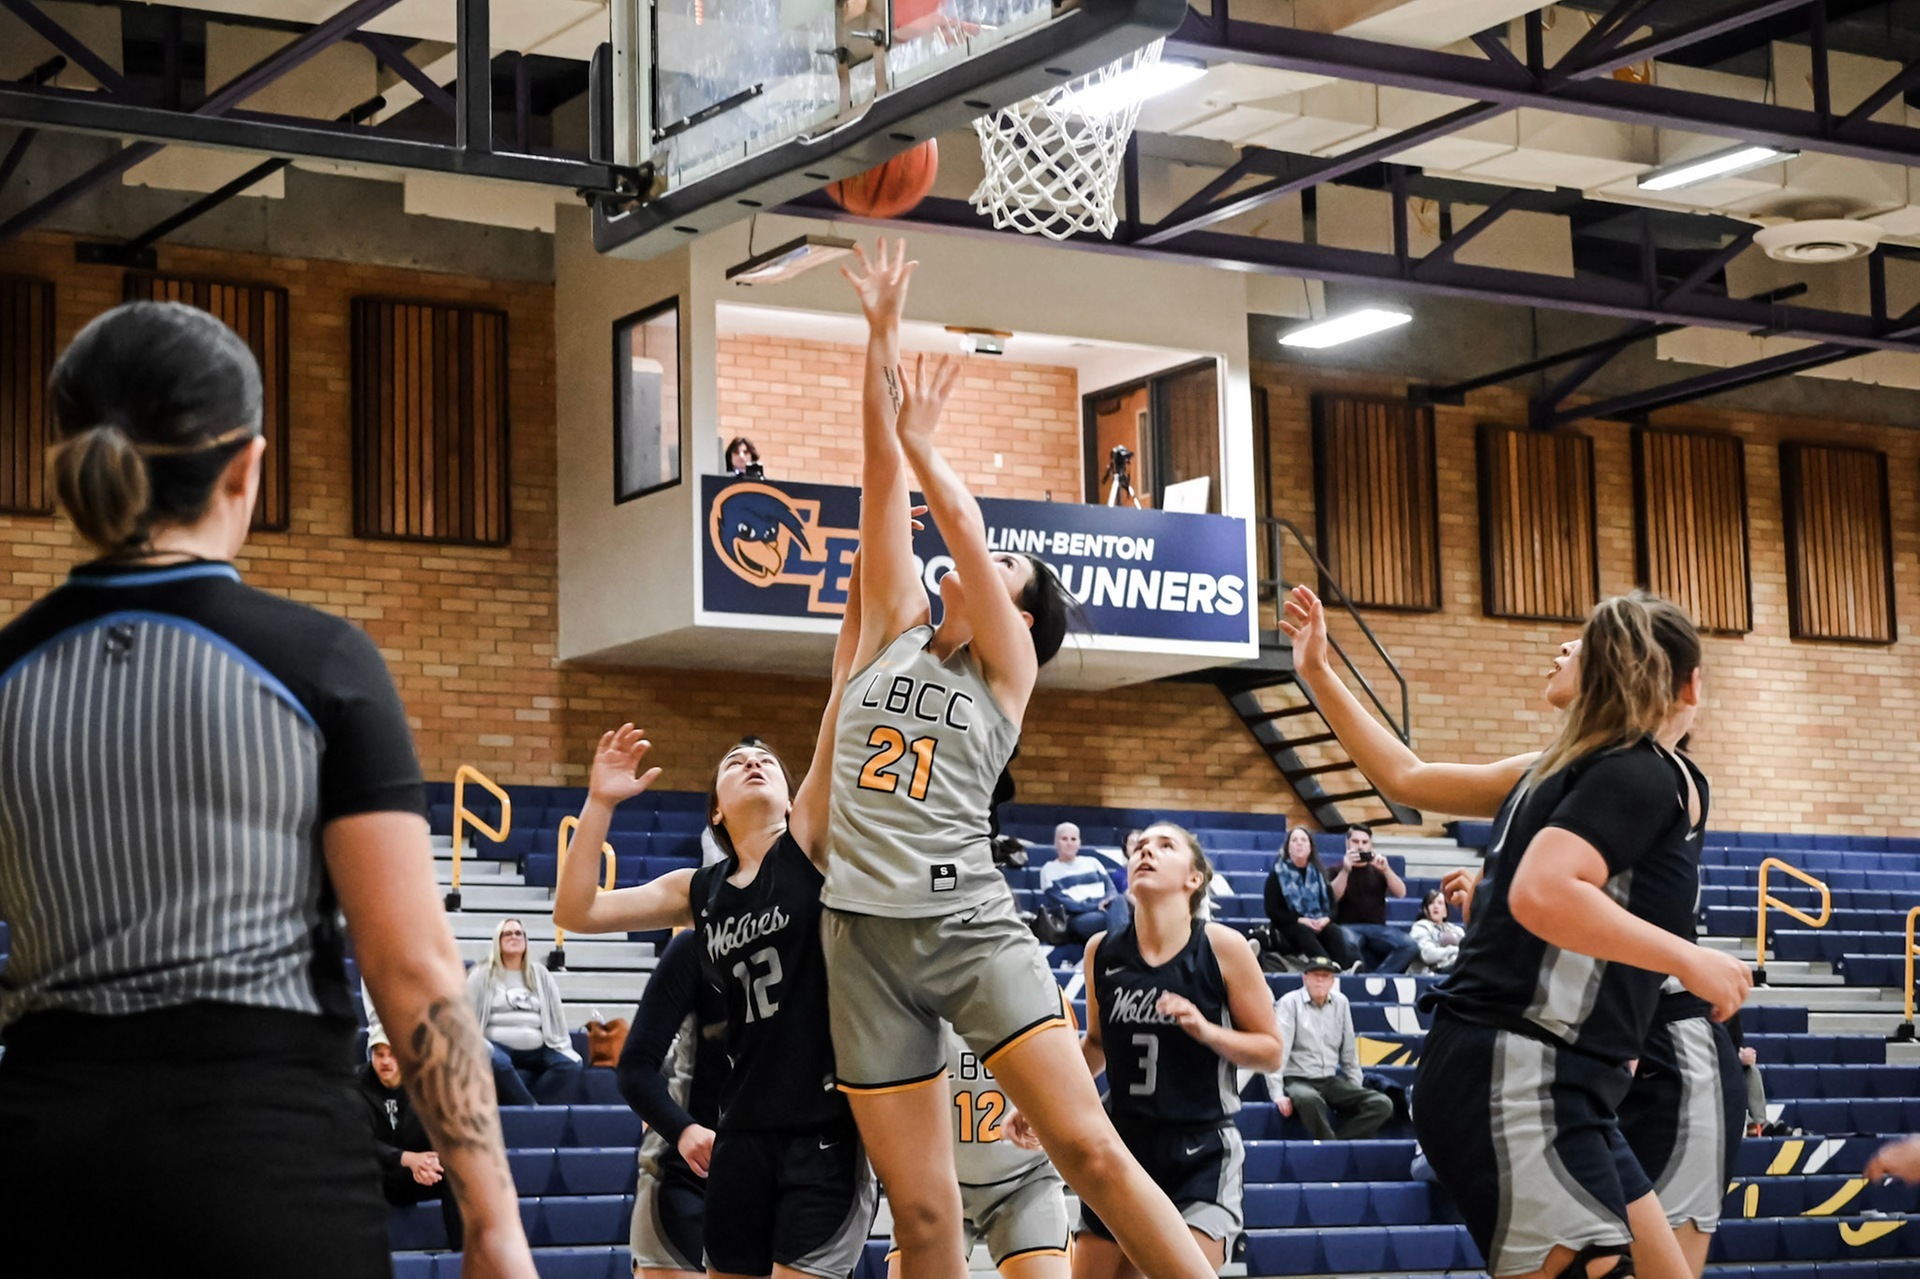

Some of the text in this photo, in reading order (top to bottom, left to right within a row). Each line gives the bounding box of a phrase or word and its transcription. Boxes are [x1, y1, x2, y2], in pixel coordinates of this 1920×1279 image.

[986, 527, 1155, 561] LINN-BENTON
[860, 673, 973, 732] LBCC
[857, 724, 938, 802] 21
[703, 905, 790, 964] Wolves
[732, 946, 784, 1024] 12
[1129, 1033, 1160, 1096] 3
[953, 1089, 1007, 1144] 12
